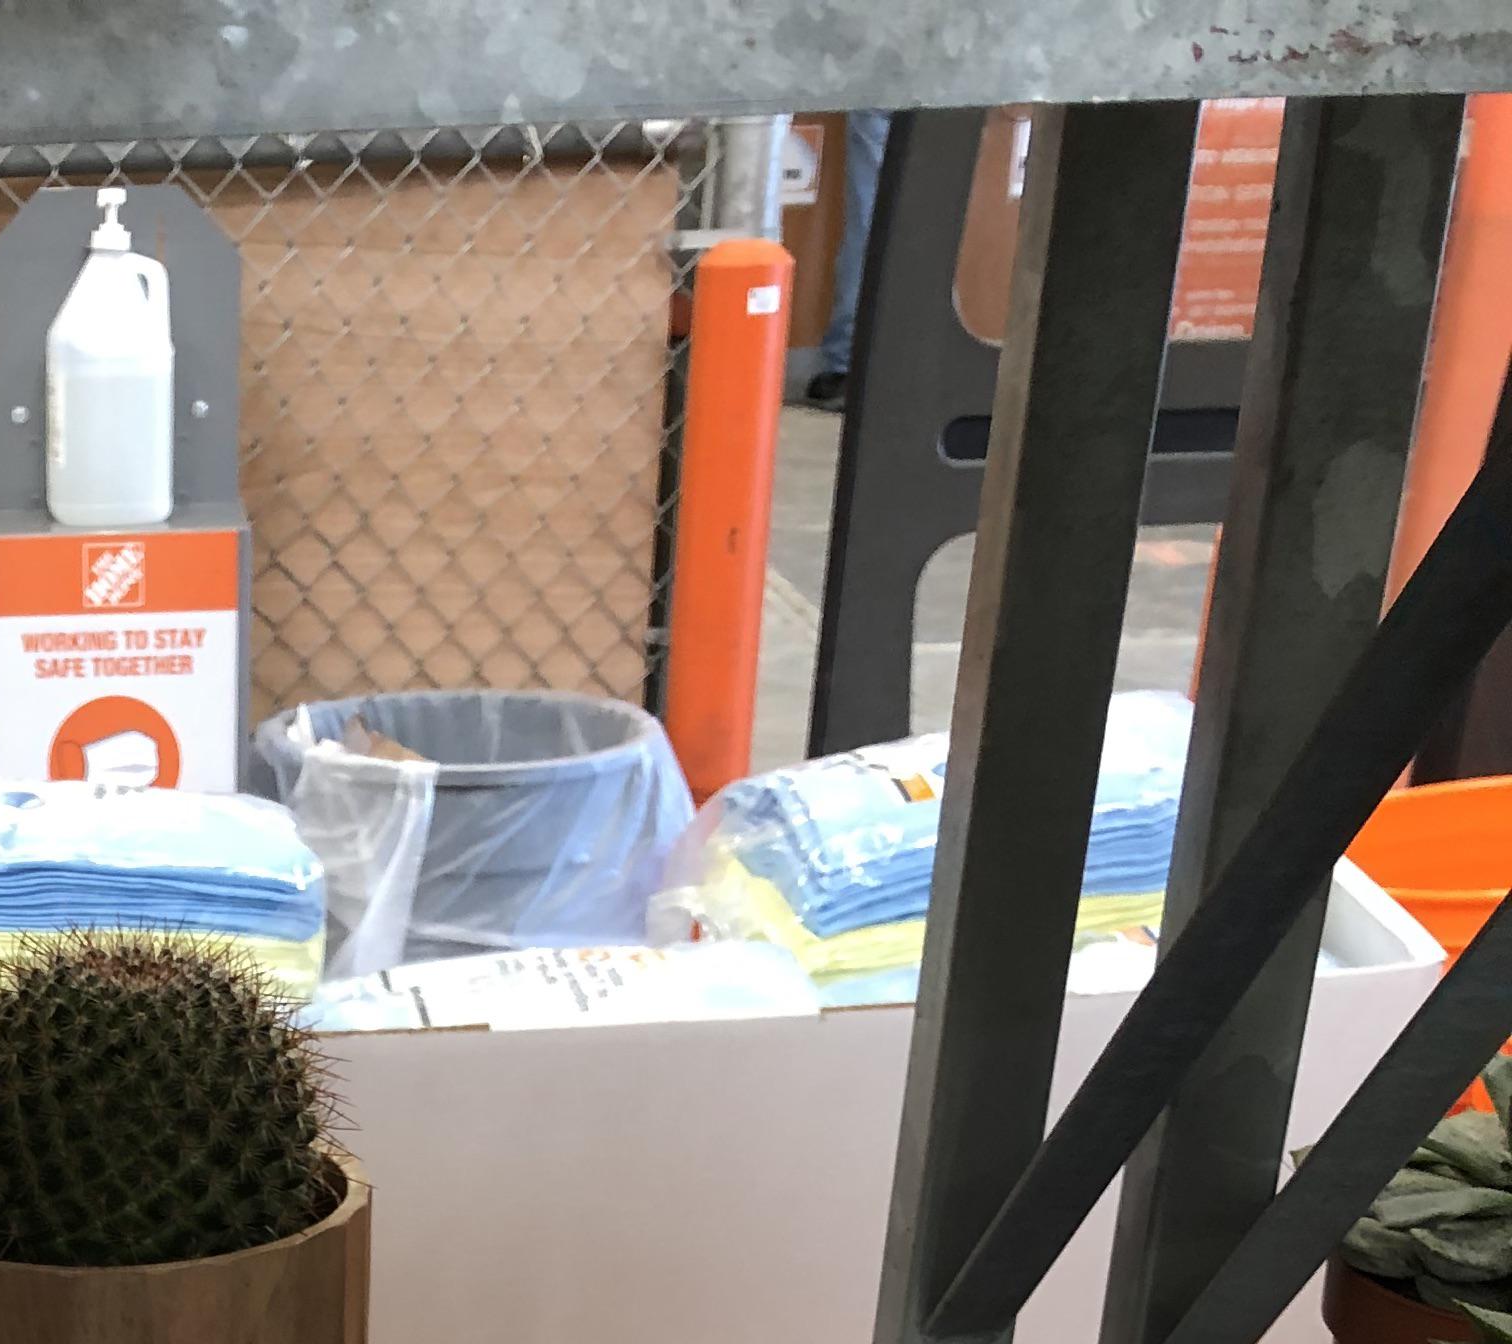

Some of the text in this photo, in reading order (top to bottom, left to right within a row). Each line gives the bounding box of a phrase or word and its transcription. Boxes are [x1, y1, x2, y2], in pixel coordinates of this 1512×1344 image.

[21, 628, 207, 653] WORKING TO STAY
[35, 654, 194, 679] SAFE TOGETHER
